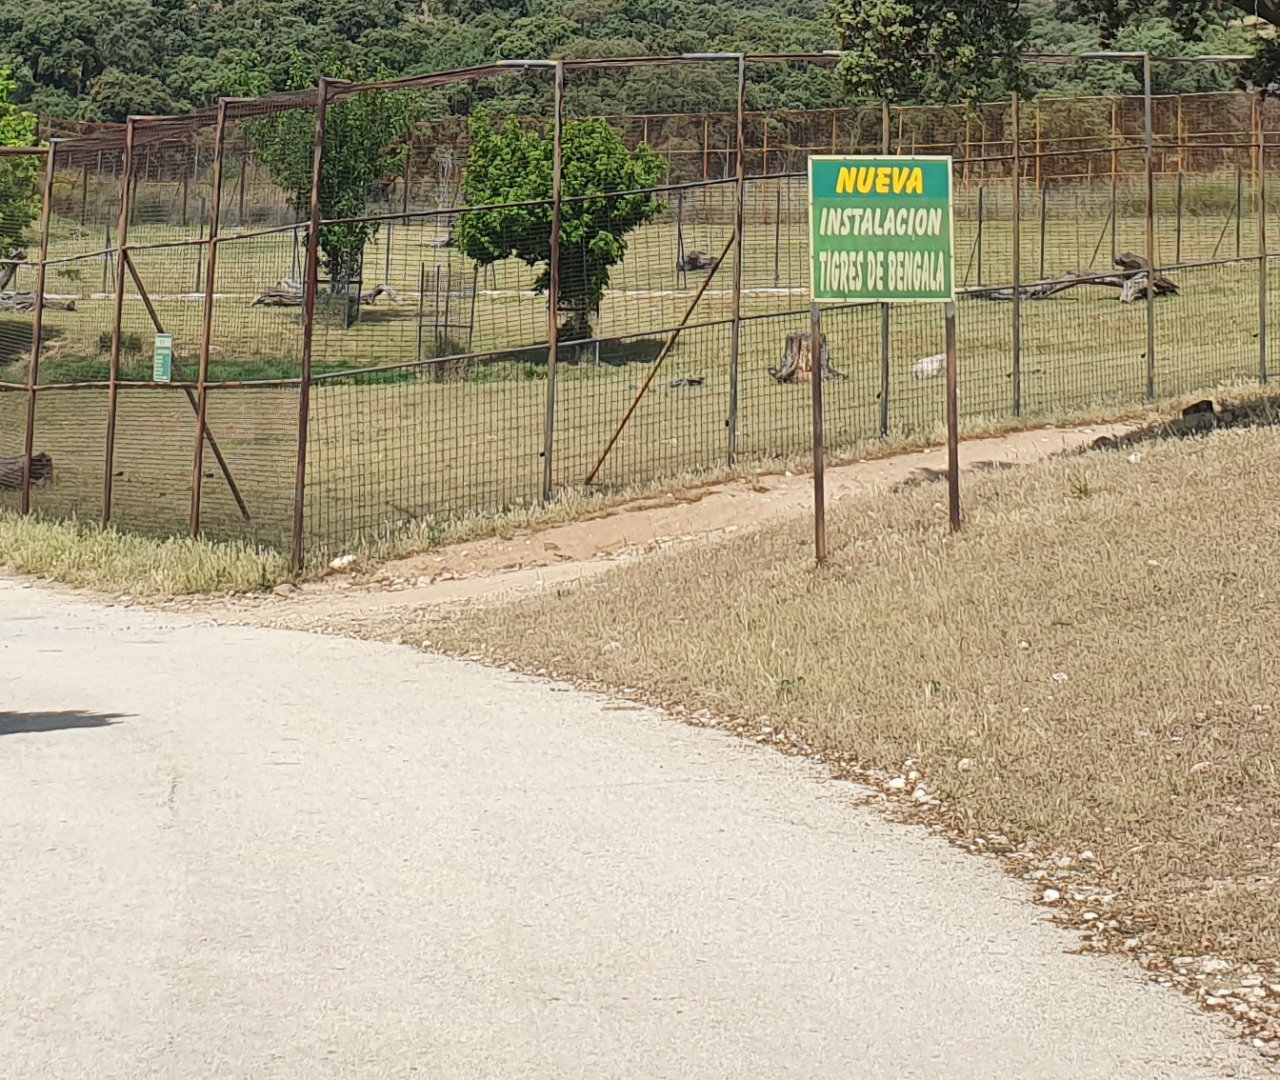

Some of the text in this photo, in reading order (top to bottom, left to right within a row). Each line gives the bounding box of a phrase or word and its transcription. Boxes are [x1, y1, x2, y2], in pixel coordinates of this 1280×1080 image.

[836, 167, 923, 194] NUEVA
[819, 207, 942, 236] INSTALACION
[819, 250, 945, 294] TIGRES DE BENGALA
